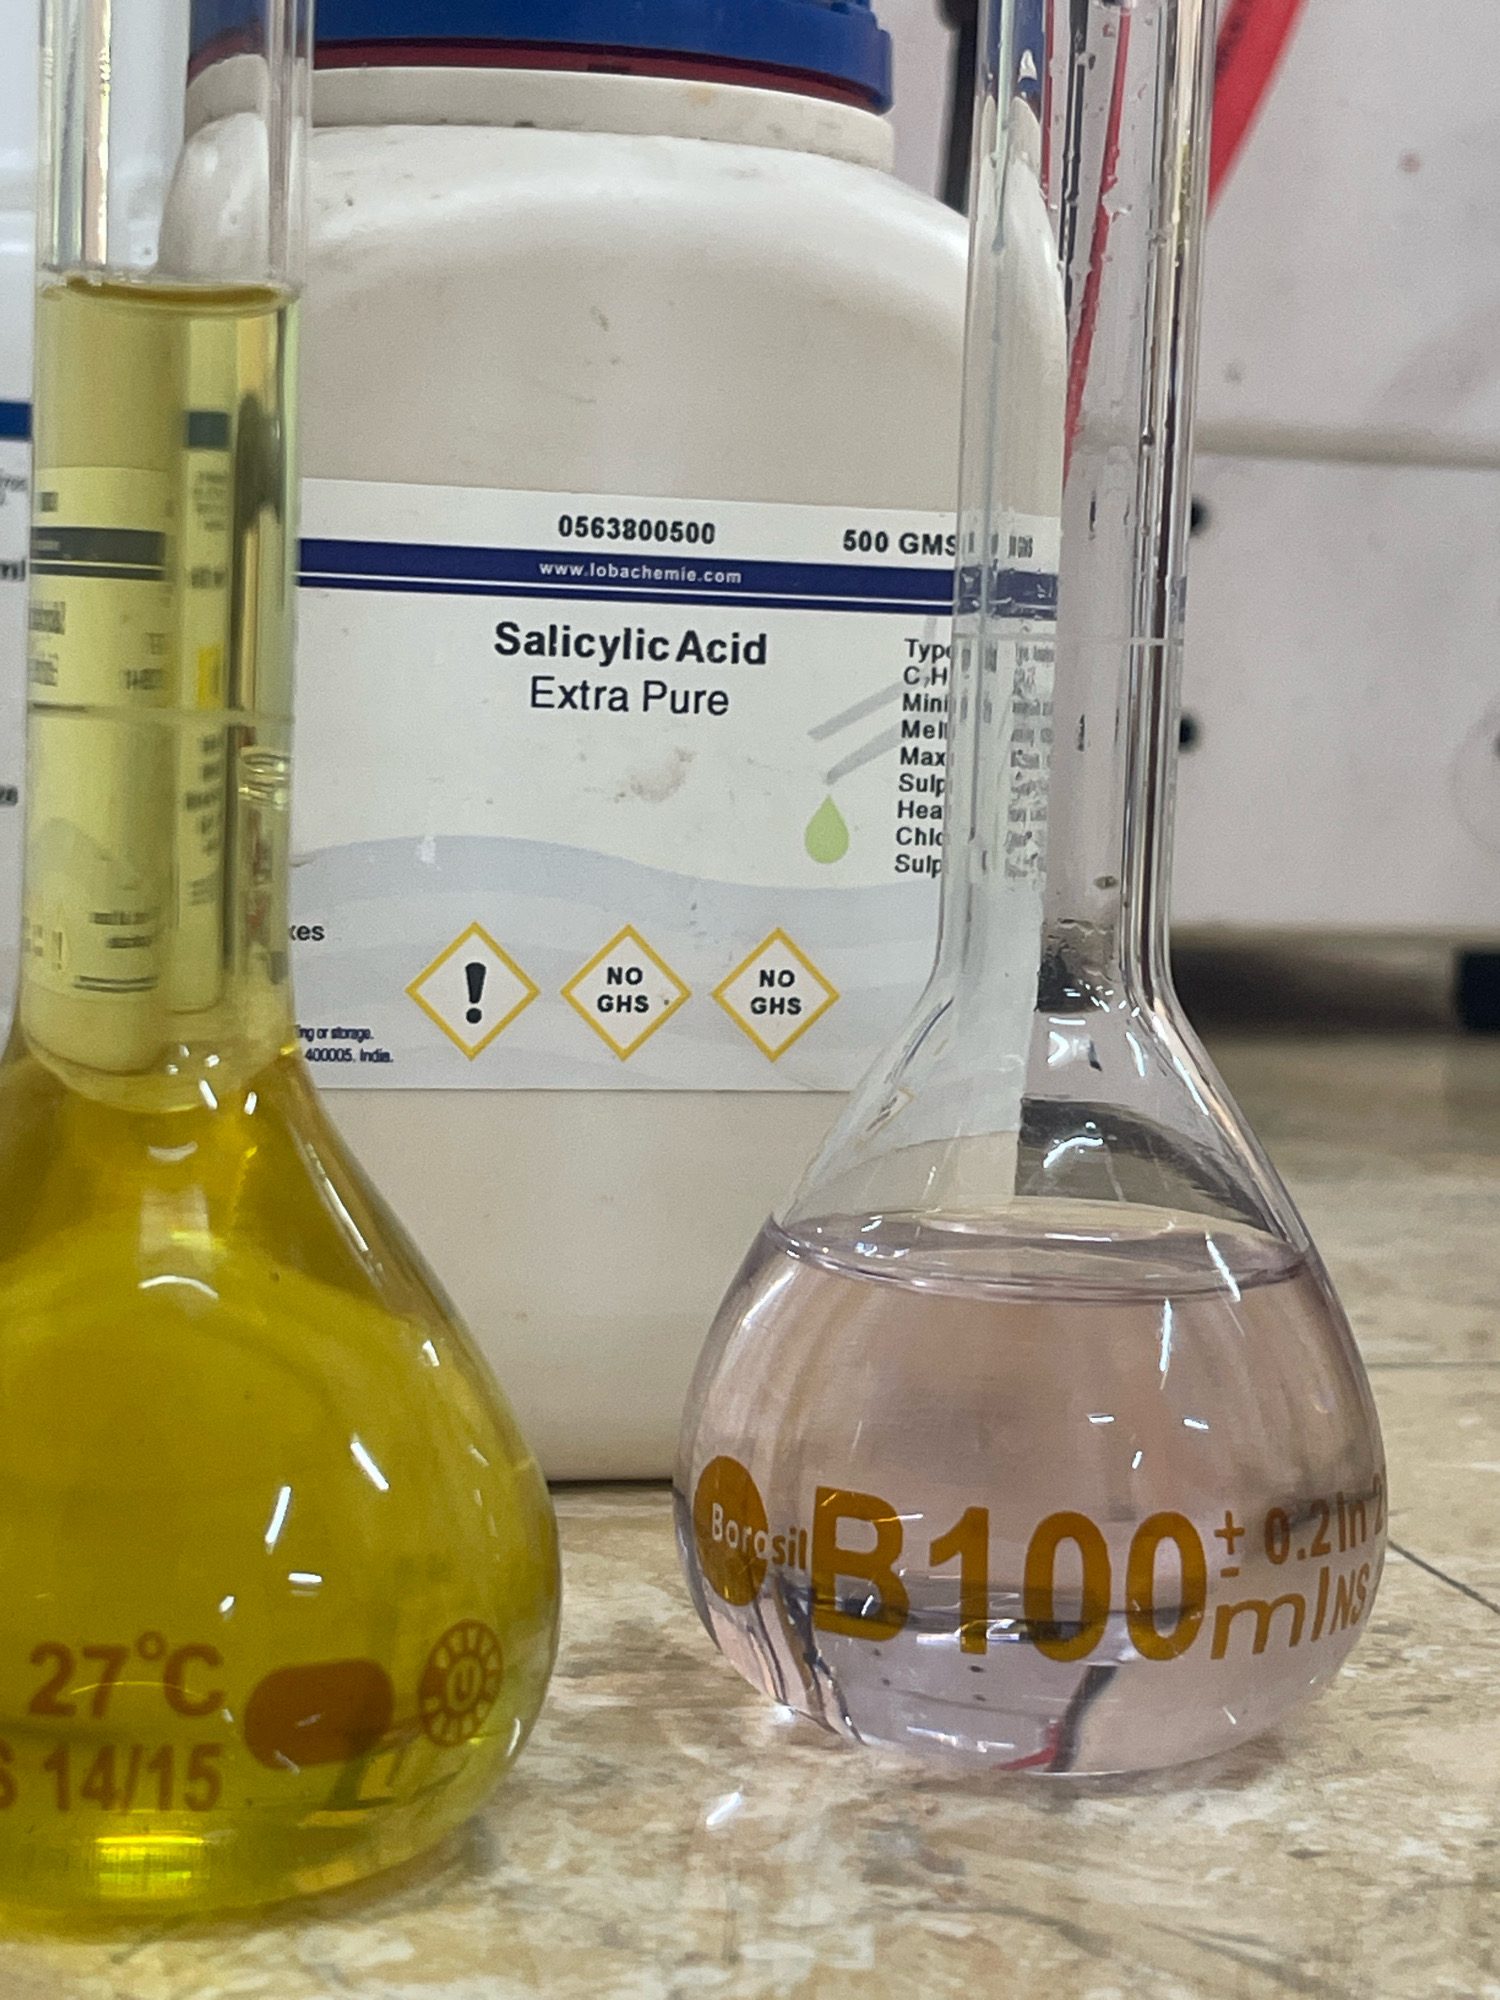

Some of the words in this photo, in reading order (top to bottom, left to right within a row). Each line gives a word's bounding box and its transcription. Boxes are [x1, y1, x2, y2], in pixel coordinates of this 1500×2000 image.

[558, 515, 716, 545] 0563800500
[843, 528, 890, 552] 500
[898, 533, 956, 556] GMS
[539, 562, 742, 584] www.lobachemie.com
[494, 621, 670, 667] Salicylic
[675, 630, 767, 665] Acid
[530, 675, 629, 712] Extra
[642, 680, 729, 716] Pure
[897, 799, 943, 820] Hea
[606, 966, 644, 985] NO
[759, 969, 795, 988] NO
[596, 994, 650, 1013] GHS
[750, 996, 802, 1015] GHS
[711, 1502, 808, 1570] Borosil
[44, 1743, 223, 1813] 14/15
